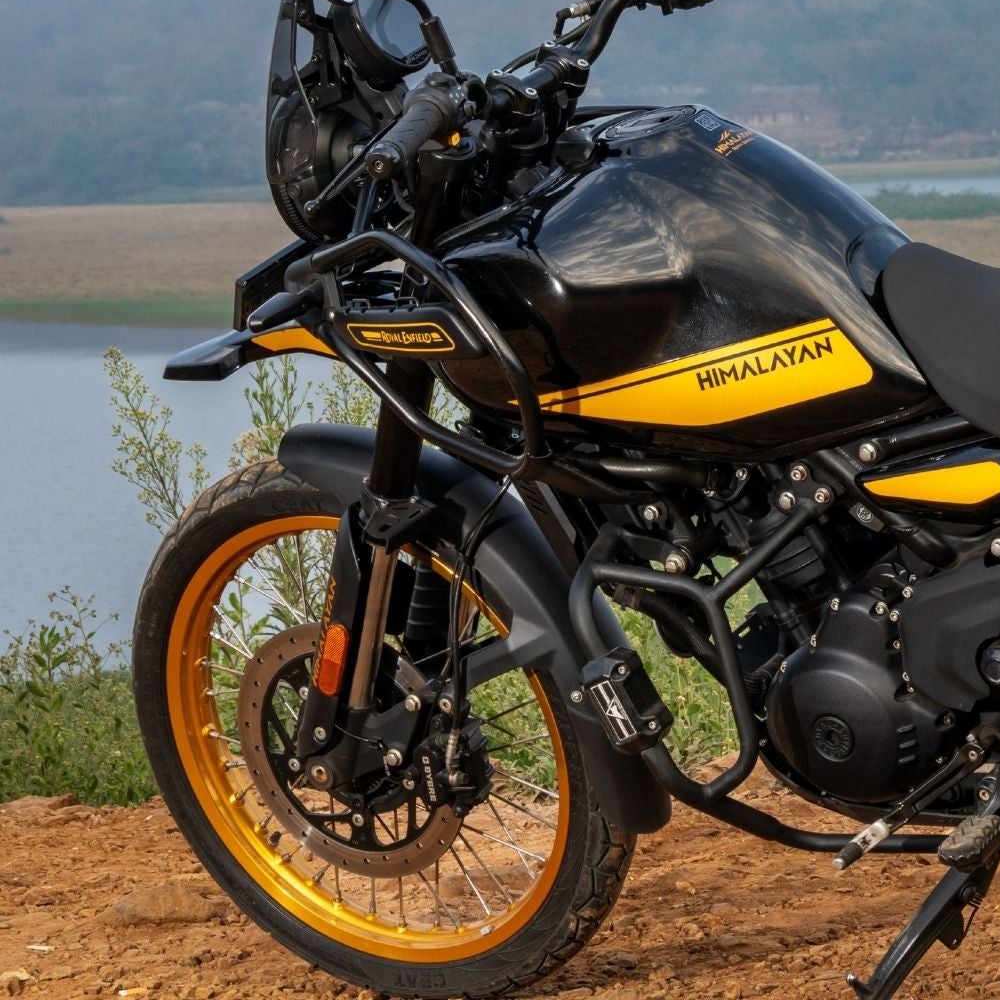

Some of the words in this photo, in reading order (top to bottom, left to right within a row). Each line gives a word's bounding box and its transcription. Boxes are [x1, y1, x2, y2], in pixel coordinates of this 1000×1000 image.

[381, 331, 402, 343] ROYAL
[402, 332, 432, 344] ENFIELD
[696, 336, 833, 391] HIMALAYAN
[424, 766, 437, 802] BYBRE
[392, 971, 447, 989] CEAT
